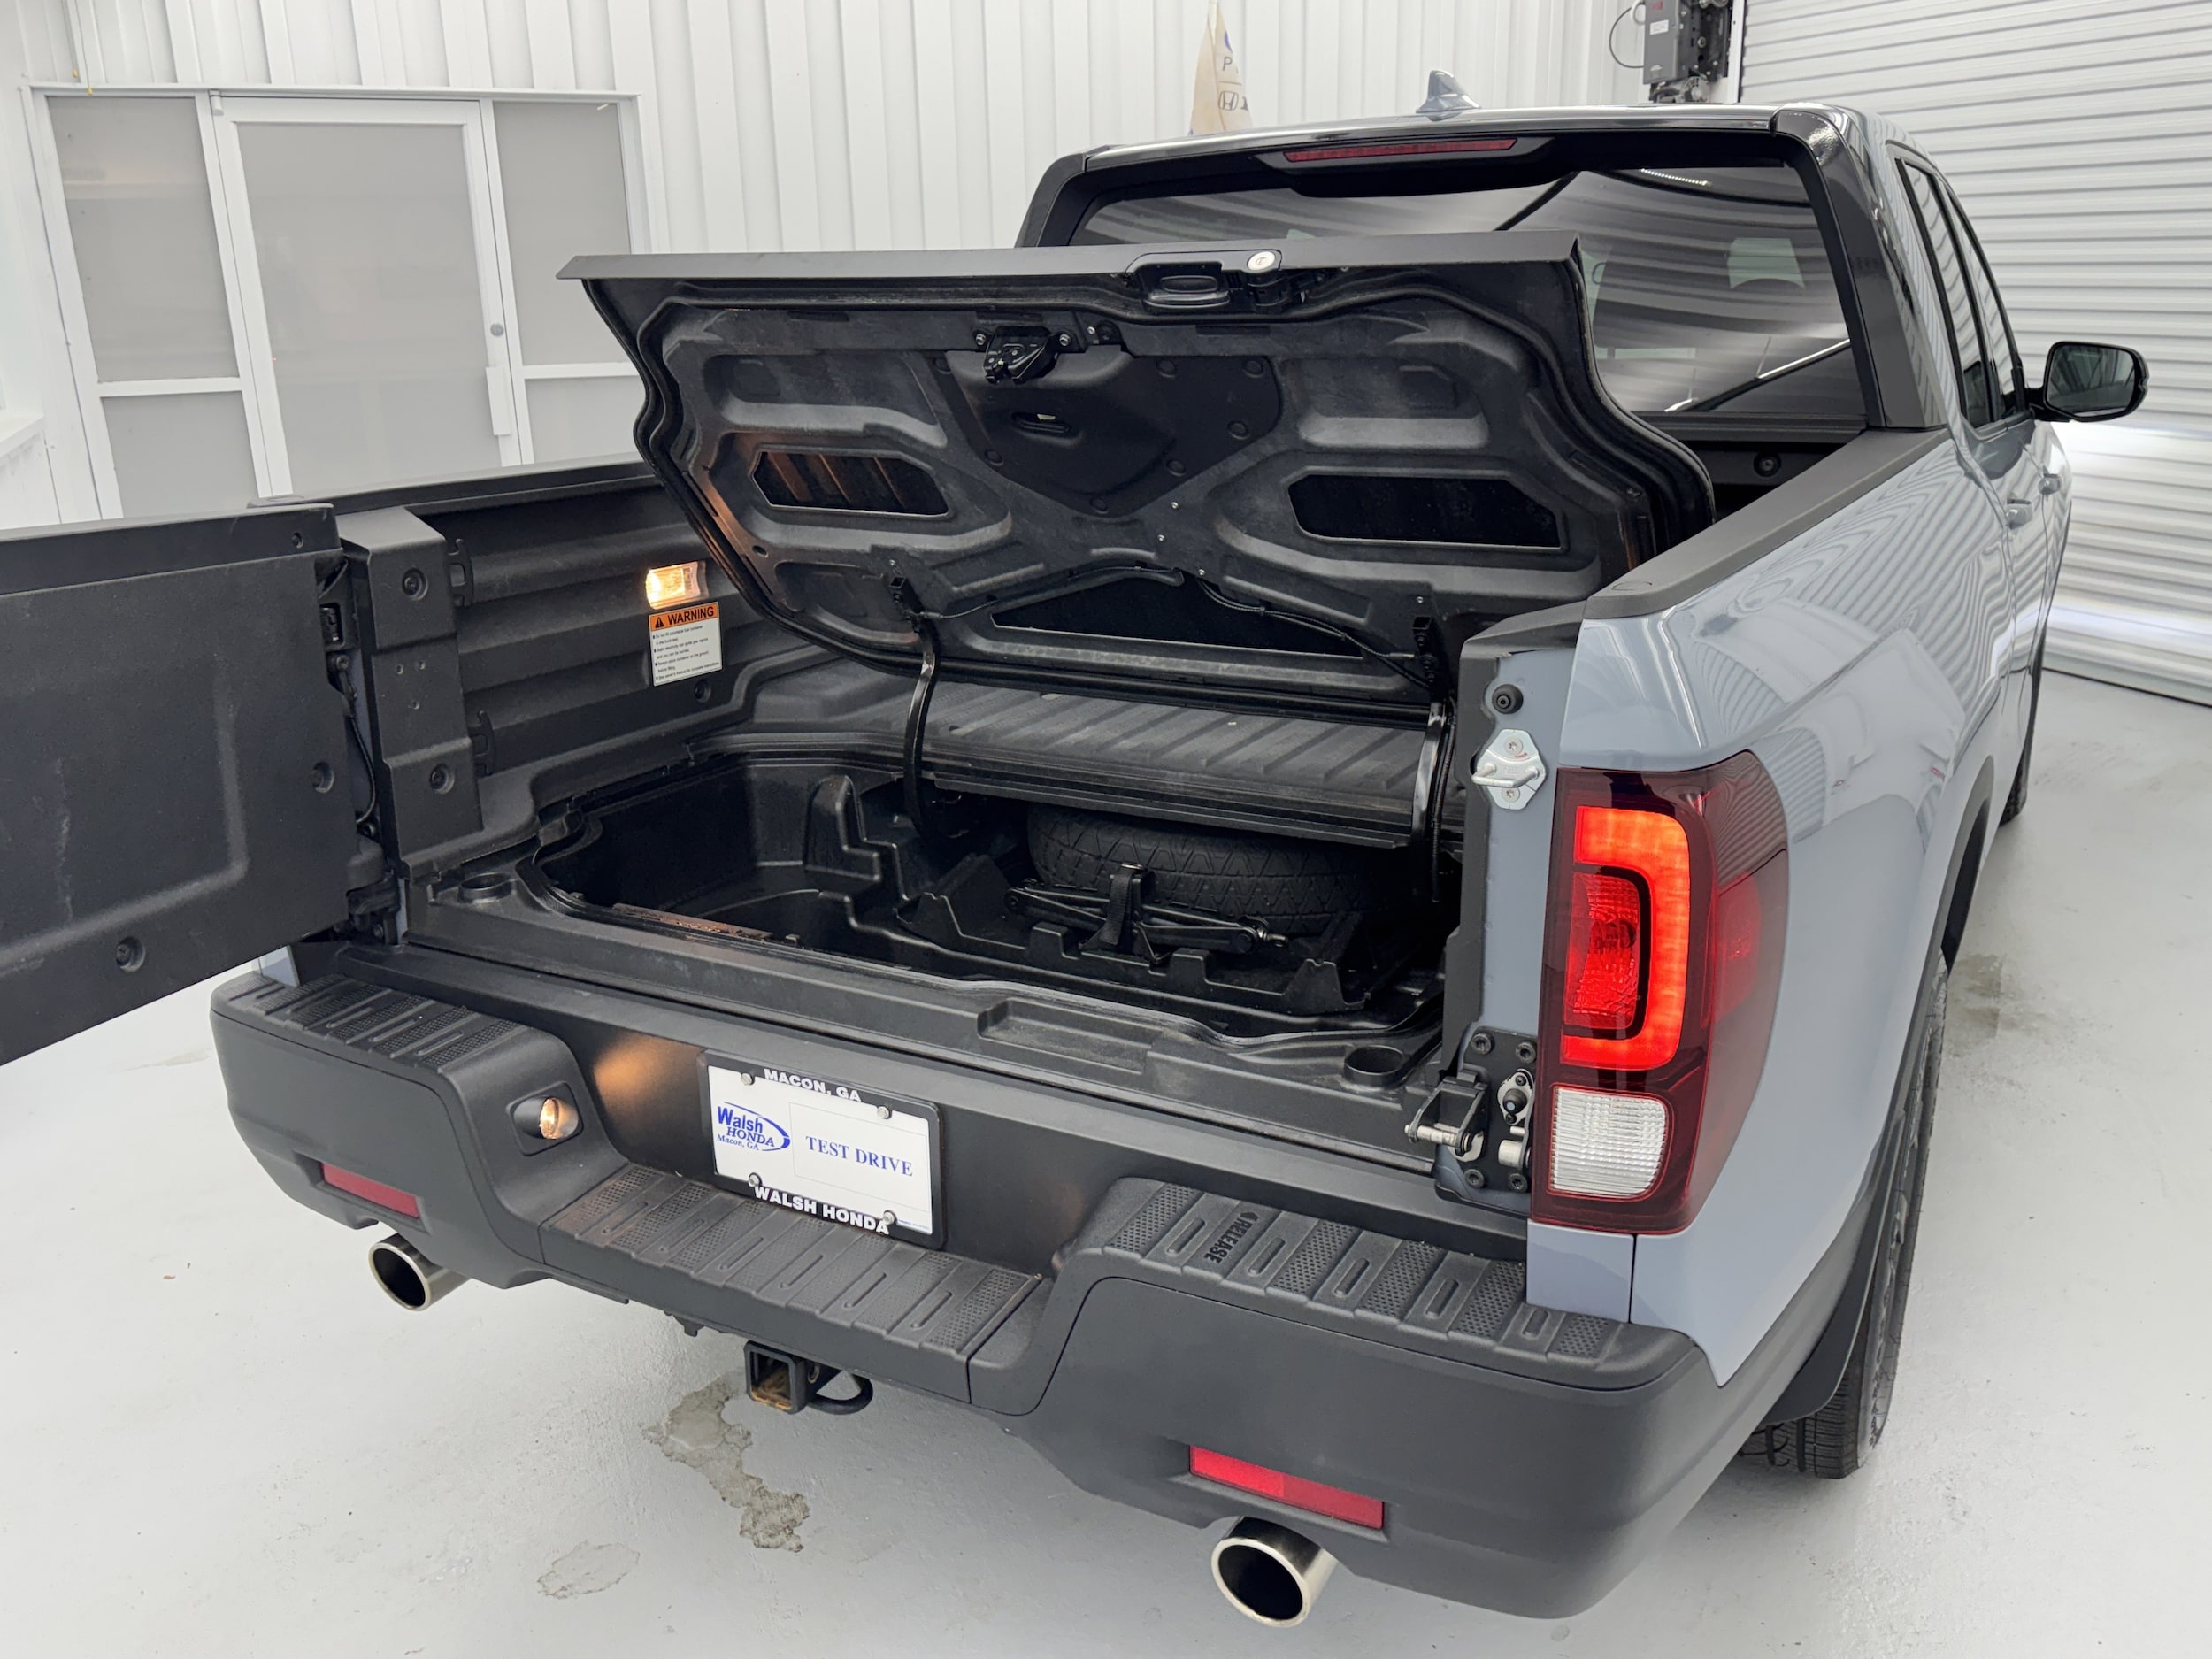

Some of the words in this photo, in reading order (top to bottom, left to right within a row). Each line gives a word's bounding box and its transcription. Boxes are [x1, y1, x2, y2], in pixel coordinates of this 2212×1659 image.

[667, 606, 714, 626] WARNING
[764, 1068, 832, 1095] MACON,
[836, 1087, 862, 1102] GA
[718, 1106, 763, 1133] Walsh
[718, 1133, 745, 1148] Macon,
[746, 1141, 759, 1150] GA
[726, 1126, 775, 1147] HONDA
[805, 1135, 850, 1159] TEST
[855, 1148, 913, 1177] DRIVE
[754, 1186, 817, 1214] WALSH
[822, 1204, 890, 1235] HONDA
[1203, 1217, 1254, 1263] RELEASE
